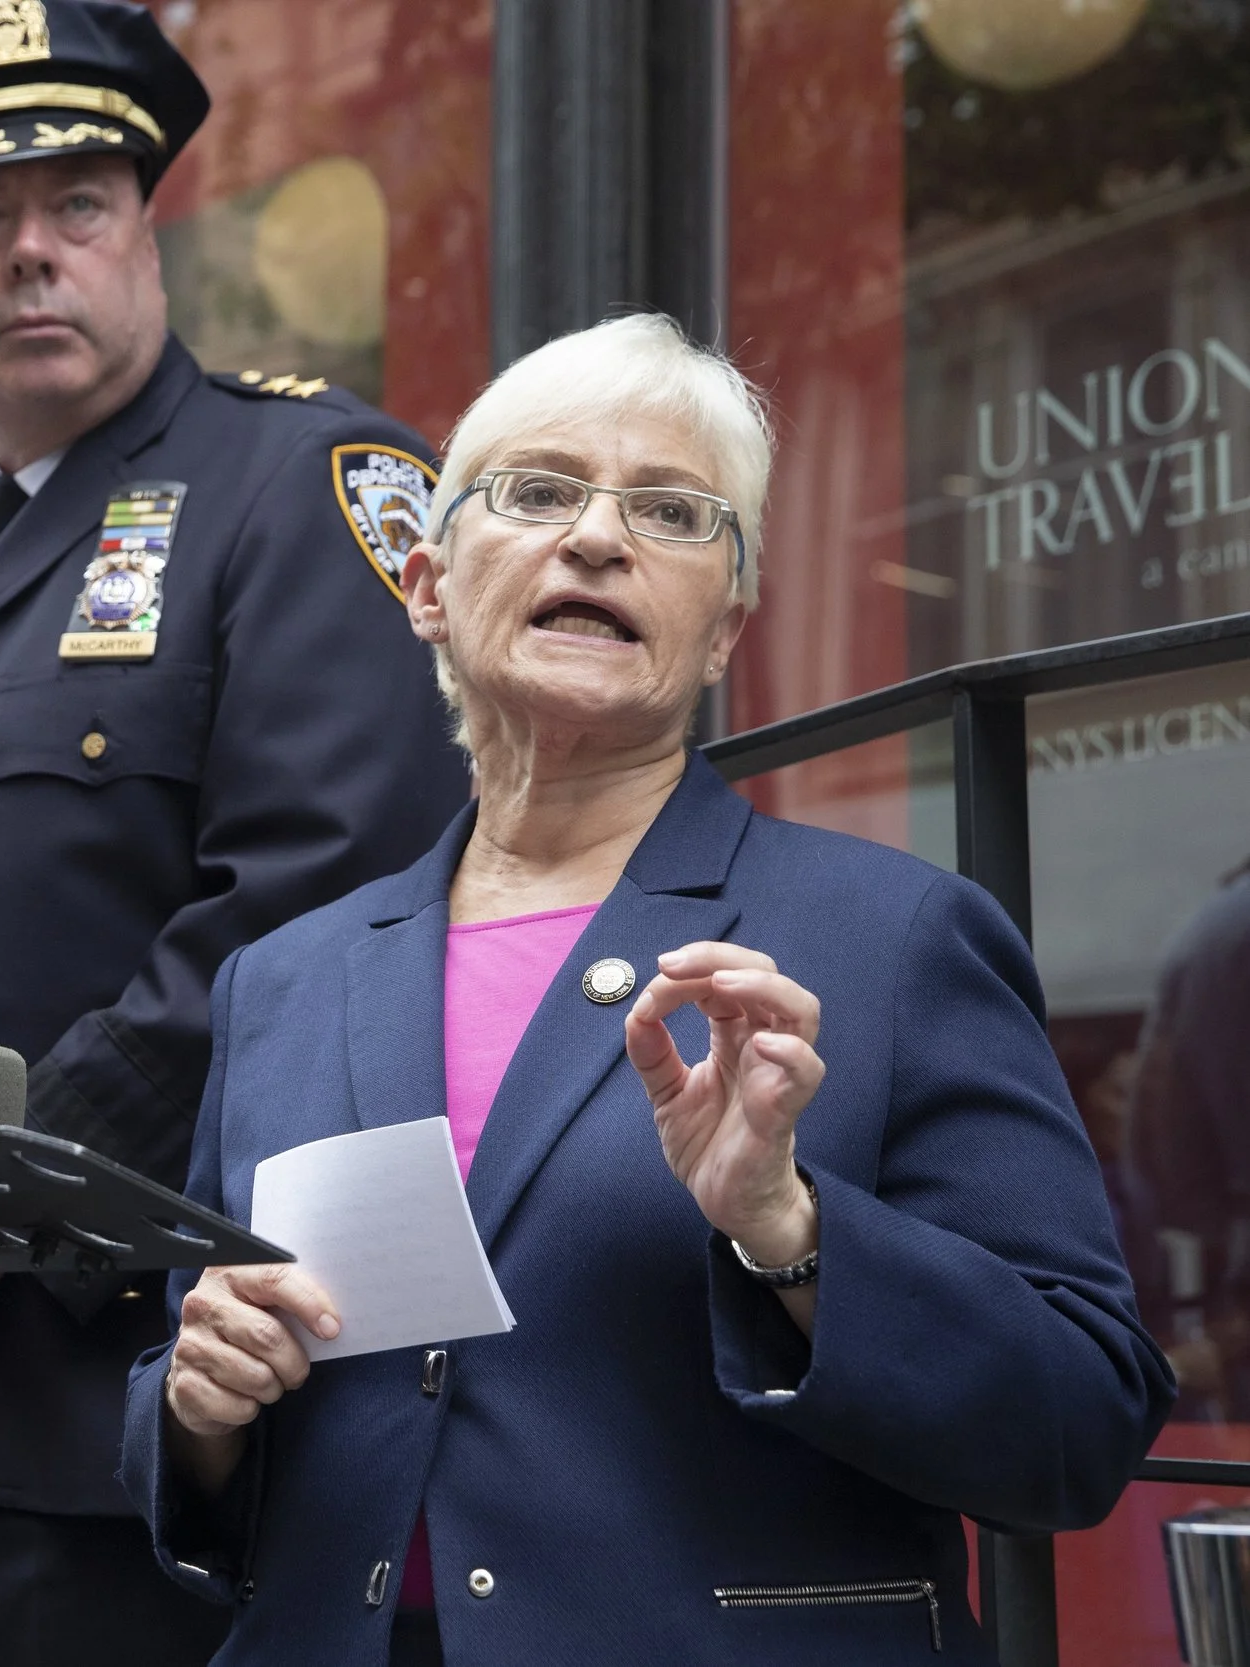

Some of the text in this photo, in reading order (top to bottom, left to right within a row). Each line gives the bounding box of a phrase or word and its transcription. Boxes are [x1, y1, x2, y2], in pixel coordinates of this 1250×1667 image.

[978, 337, 1250, 480] UNION
[368, 453, 426, 479] POLICE
[350, 504, 379, 546] CITY
[1141, 556, 1164, 589] a
[1031, 721, 1115, 776] NYS
